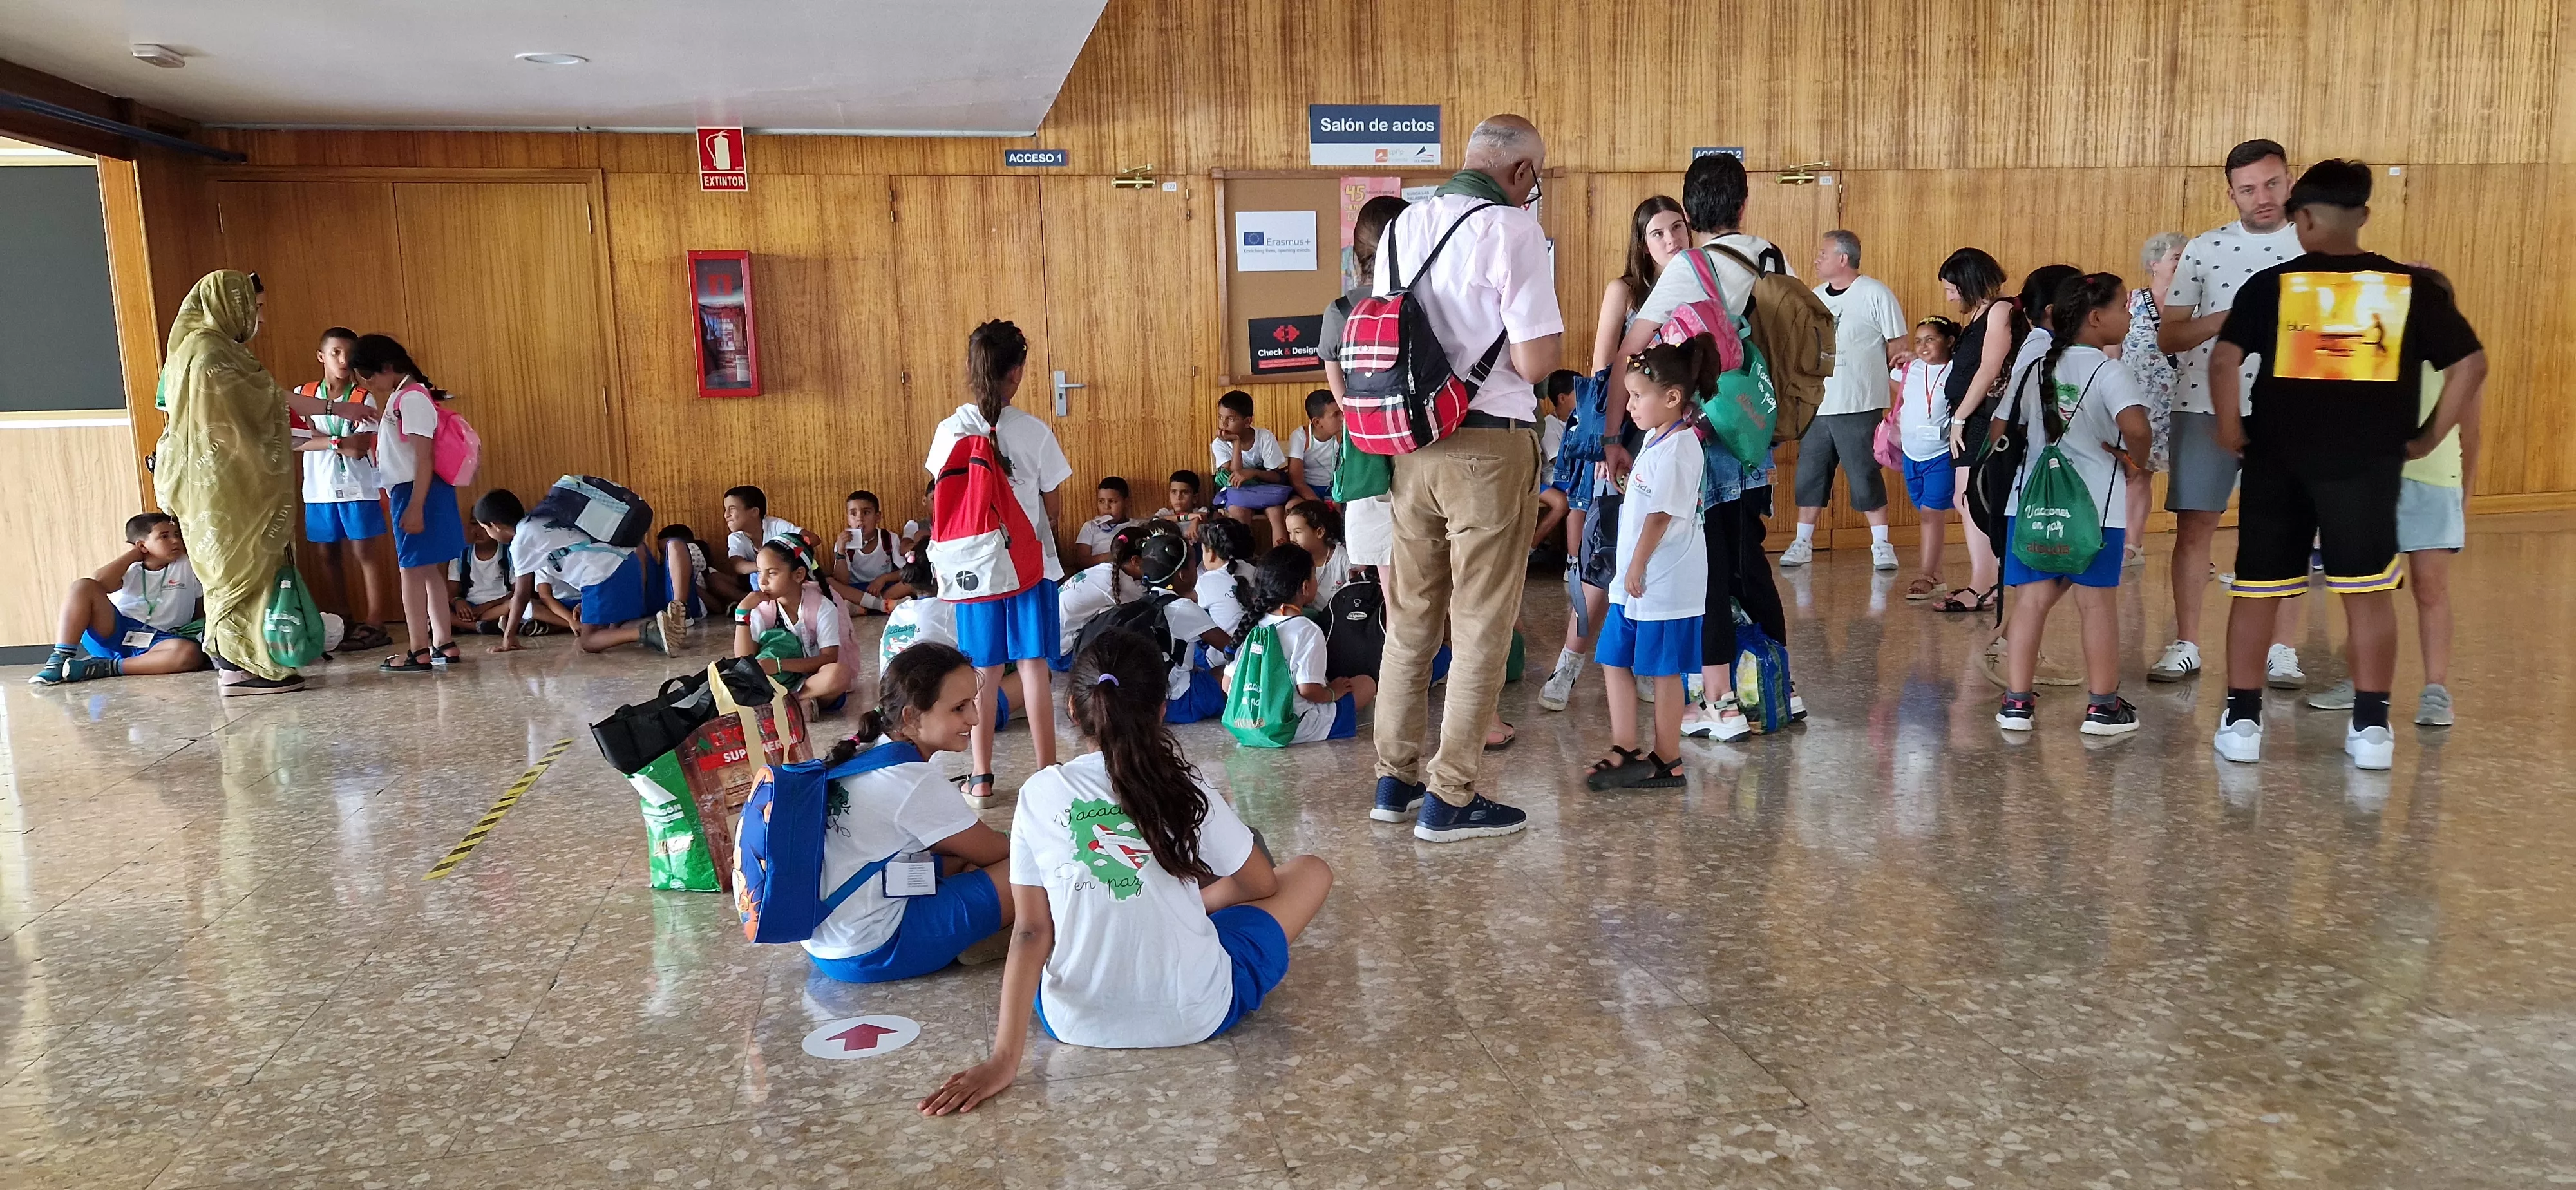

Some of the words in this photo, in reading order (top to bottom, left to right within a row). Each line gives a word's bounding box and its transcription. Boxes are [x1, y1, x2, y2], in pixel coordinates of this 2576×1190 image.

[1321, 117, 1365, 132] Salón
[1369, 118, 1388, 132] de
[1392, 118, 1435, 132] actos
[1009, 153, 1054, 163] ACCESO
[1057, 153, 1062, 163] 1
[1736, 150, 1741, 159] 2
[704, 176, 744, 187] EXTINTOR
[1345, 185, 1366, 202] 45
[1258, 348, 1283, 357] Check
[1292, 346, 1318, 355] Design
[1054, 806, 1126, 827] Vacaci
[1074, 880, 1096, 891] en
[1107, 876, 1144, 899] paz
